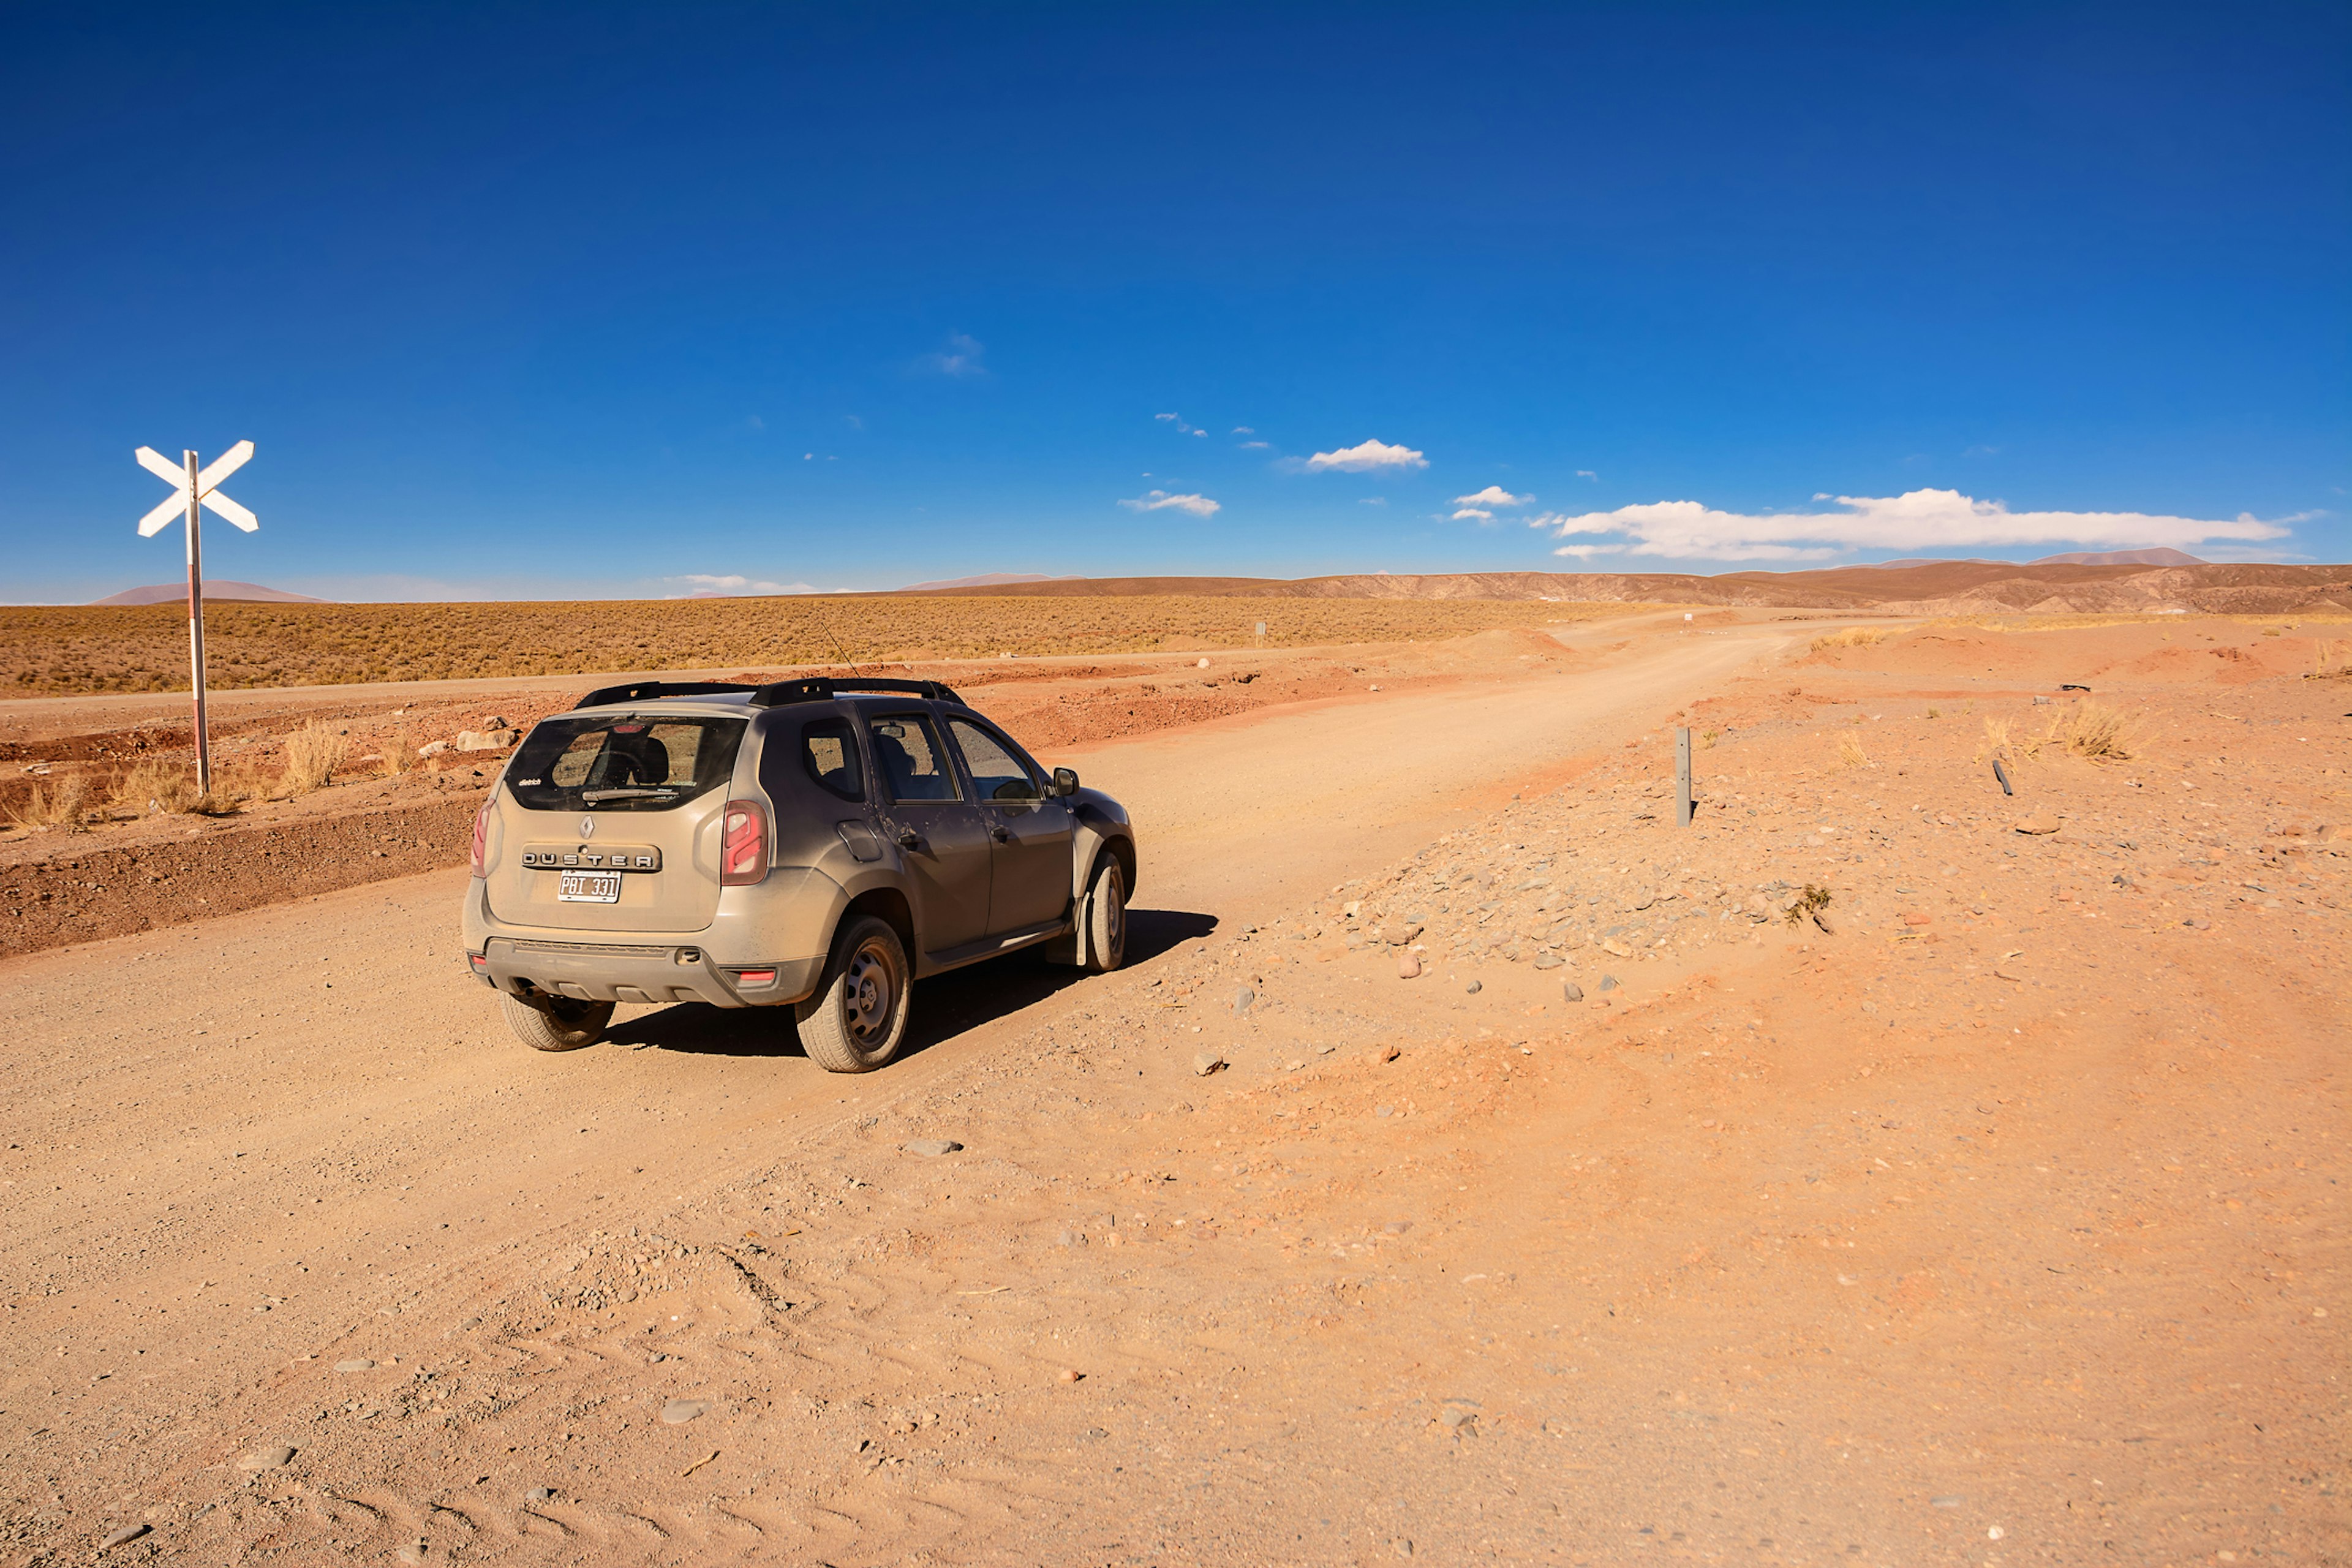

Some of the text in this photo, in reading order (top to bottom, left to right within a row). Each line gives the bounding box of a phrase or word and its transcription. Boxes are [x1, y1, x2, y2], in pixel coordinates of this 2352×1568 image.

[522, 853, 653, 867] DUSTER
[560, 876, 615, 896] PBI 331
